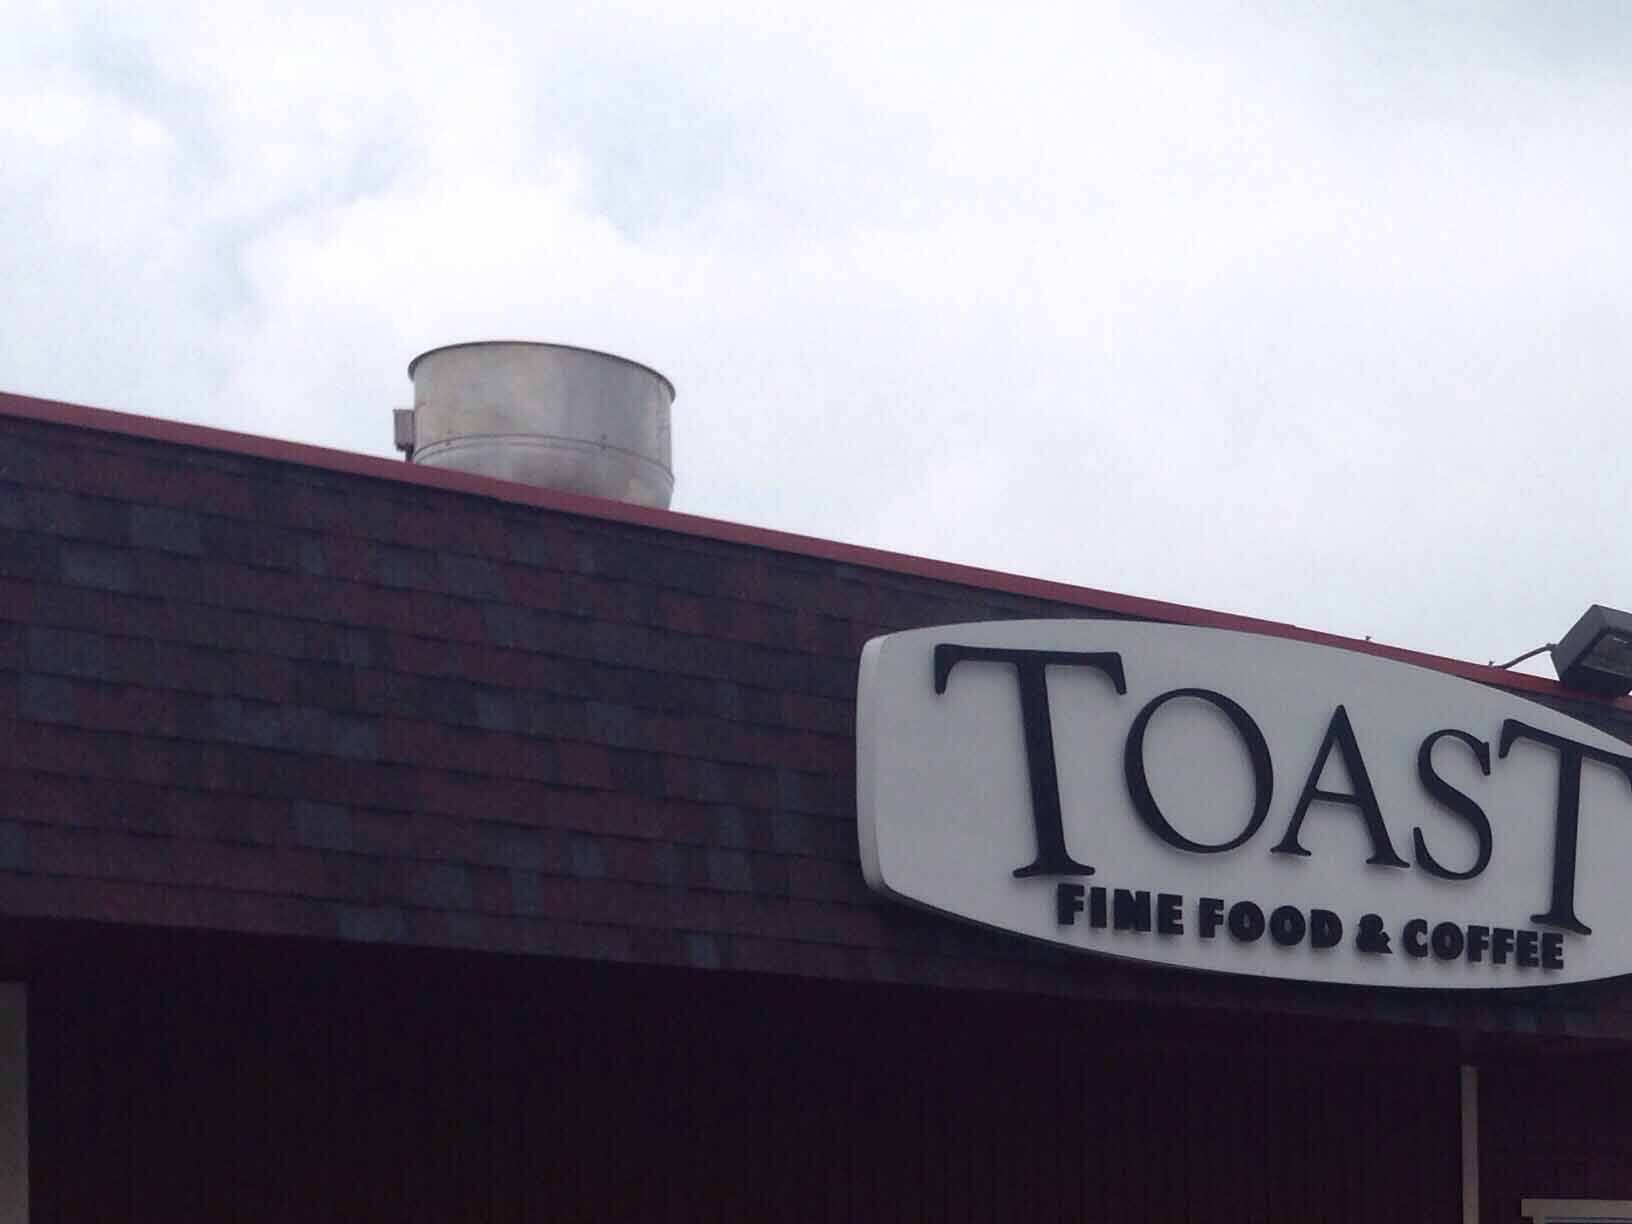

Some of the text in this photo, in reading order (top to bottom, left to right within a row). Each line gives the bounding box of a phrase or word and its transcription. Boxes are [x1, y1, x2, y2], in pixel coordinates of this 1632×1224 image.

[1057, 883, 1564, 970] FINE FOOD & COFFEE
